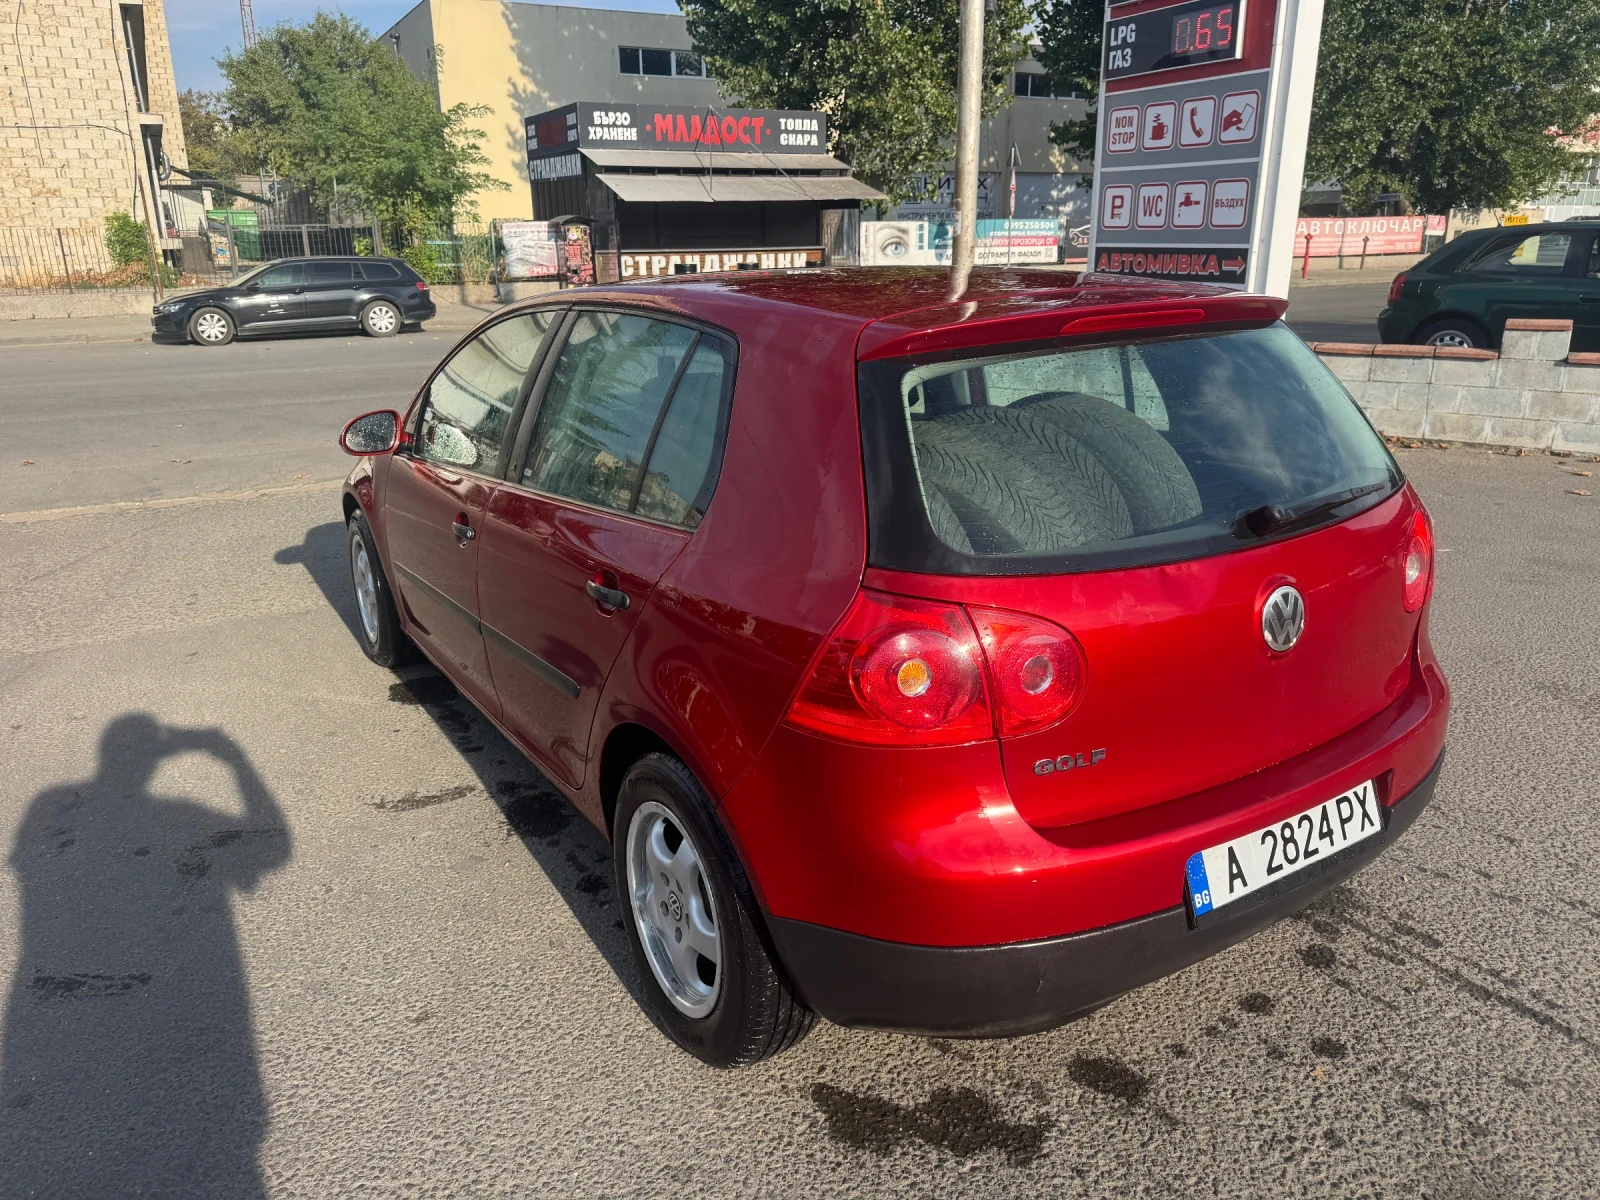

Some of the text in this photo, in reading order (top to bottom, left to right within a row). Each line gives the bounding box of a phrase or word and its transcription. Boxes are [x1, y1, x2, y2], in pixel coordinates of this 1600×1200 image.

[1110, 23, 1136, 47] LPG
[1175, 8, 1232, 53] 0.65
[1108, 48, 1132, 70] ГАЗ
[593, 111, 630, 126] БЪРЗО
[779, 118, 819, 131] ТОПЛА
[1115, 115, 1134, 129] NON
[587, 126, 638, 141] ХРАНЕНЕ
[654, 113, 765, 145] МЛАДОСТ
[1111, 131, 1135, 145] STOP
[780, 133, 819, 146] СКАРА
[529, 153, 582, 181] СТРАНДЖАНКИ
[1143, 194, 1163, 217] WC
[1215, 198, 1244, 210] ВЪЗДУХ
[1296, 219, 1423, 235] АВТОКЛЮЧАР
[1011, 237, 1045, 246] ПРОЗОРЦИ
[1045, 237, 1055, 245] ОТ
[621, 252, 807, 277] СТРАНДЖАНКИ
[1096, 252, 1221, 275] АВТОМИВКА
[1033, 747, 1107, 777] GOLF
[1194, 889, 1211, 909] BG
